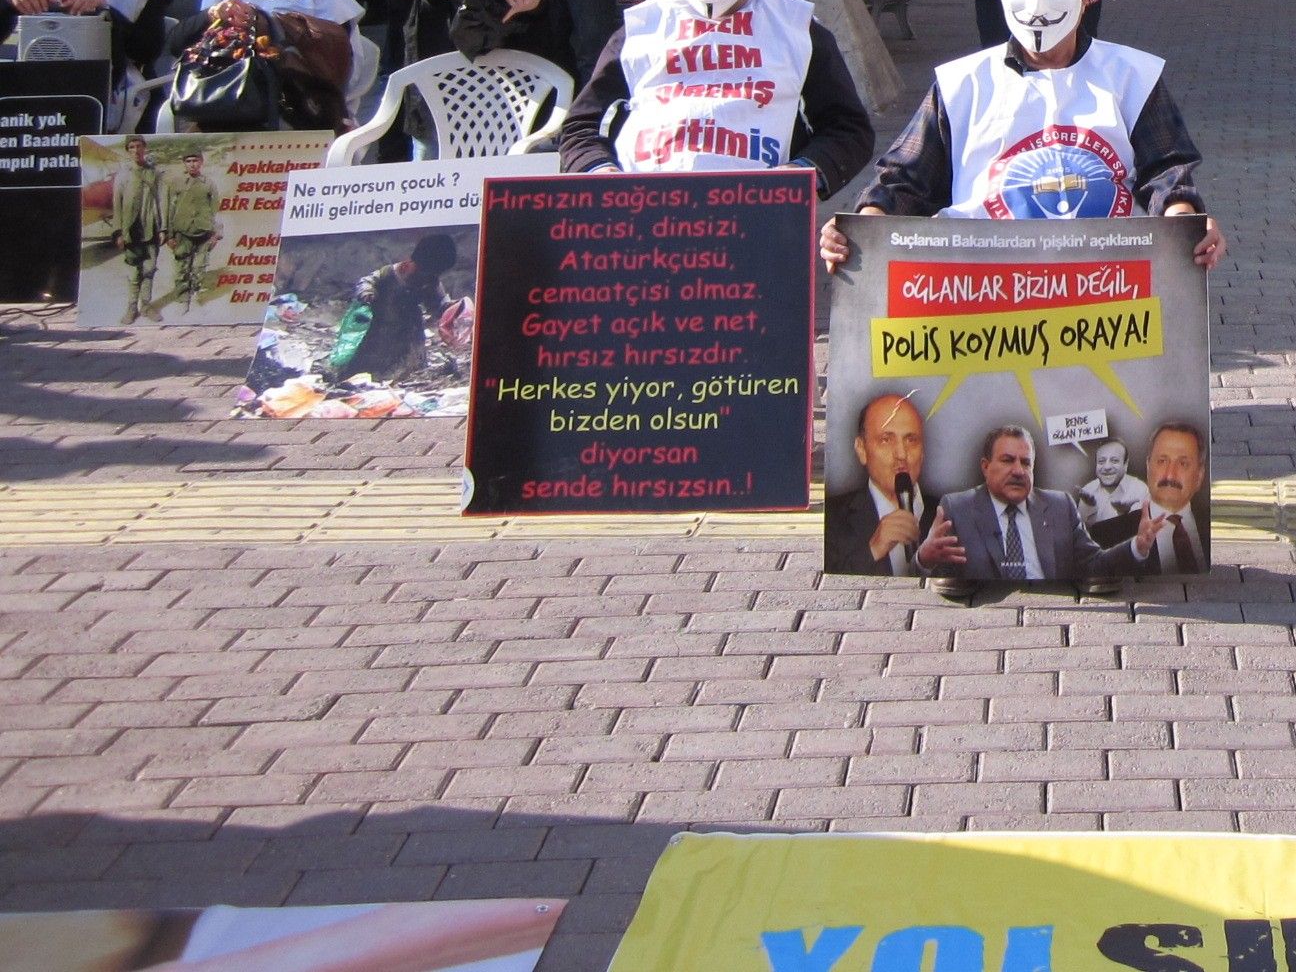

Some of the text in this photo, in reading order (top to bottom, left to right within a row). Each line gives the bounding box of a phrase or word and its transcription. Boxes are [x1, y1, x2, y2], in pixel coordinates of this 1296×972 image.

[665, 44, 762, 75] EYLEM
[38, 112, 68, 130] yok
[39, 153, 81, 172] patla
[293, 172, 461, 200] Ne arıyorsun çocuk ?
[487, 183, 810, 213] Hırsızın sağcısı, solcusu,
[219, 196, 250, 212] BİR
[289, 193, 482, 221] Milli gelirden payına dü
[550, 216, 747, 242] dincisi, dinsizi,
[890, 231, 949, 250] Suçlanan
[951, 234, 1036, 249] Bakanlardan
[1089, 232, 1153, 250] açıklama!
[559, 247, 735, 274] Atatürkçüsü,
[217, 272, 254, 288] para
[528, 277, 763, 306] cemaatçisi olmaz.
[903, 264, 1139, 305] OĞLANLAR BİZİM DEĞİL,
[230, 289, 254, 304] bir
[521, 310, 767, 341] Gayet açık ve net,
[881, 310, 1152, 367] POLİS KOYMUŞ ORAYA!
[537, 342, 749, 368] hırsız hırsızdır.
[691, 373, 800, 404] götüren
[549, 409, 641, 432] bizden
[579, 441, 700, 471] diyorsan
[521, 474, 602, 499] sende
